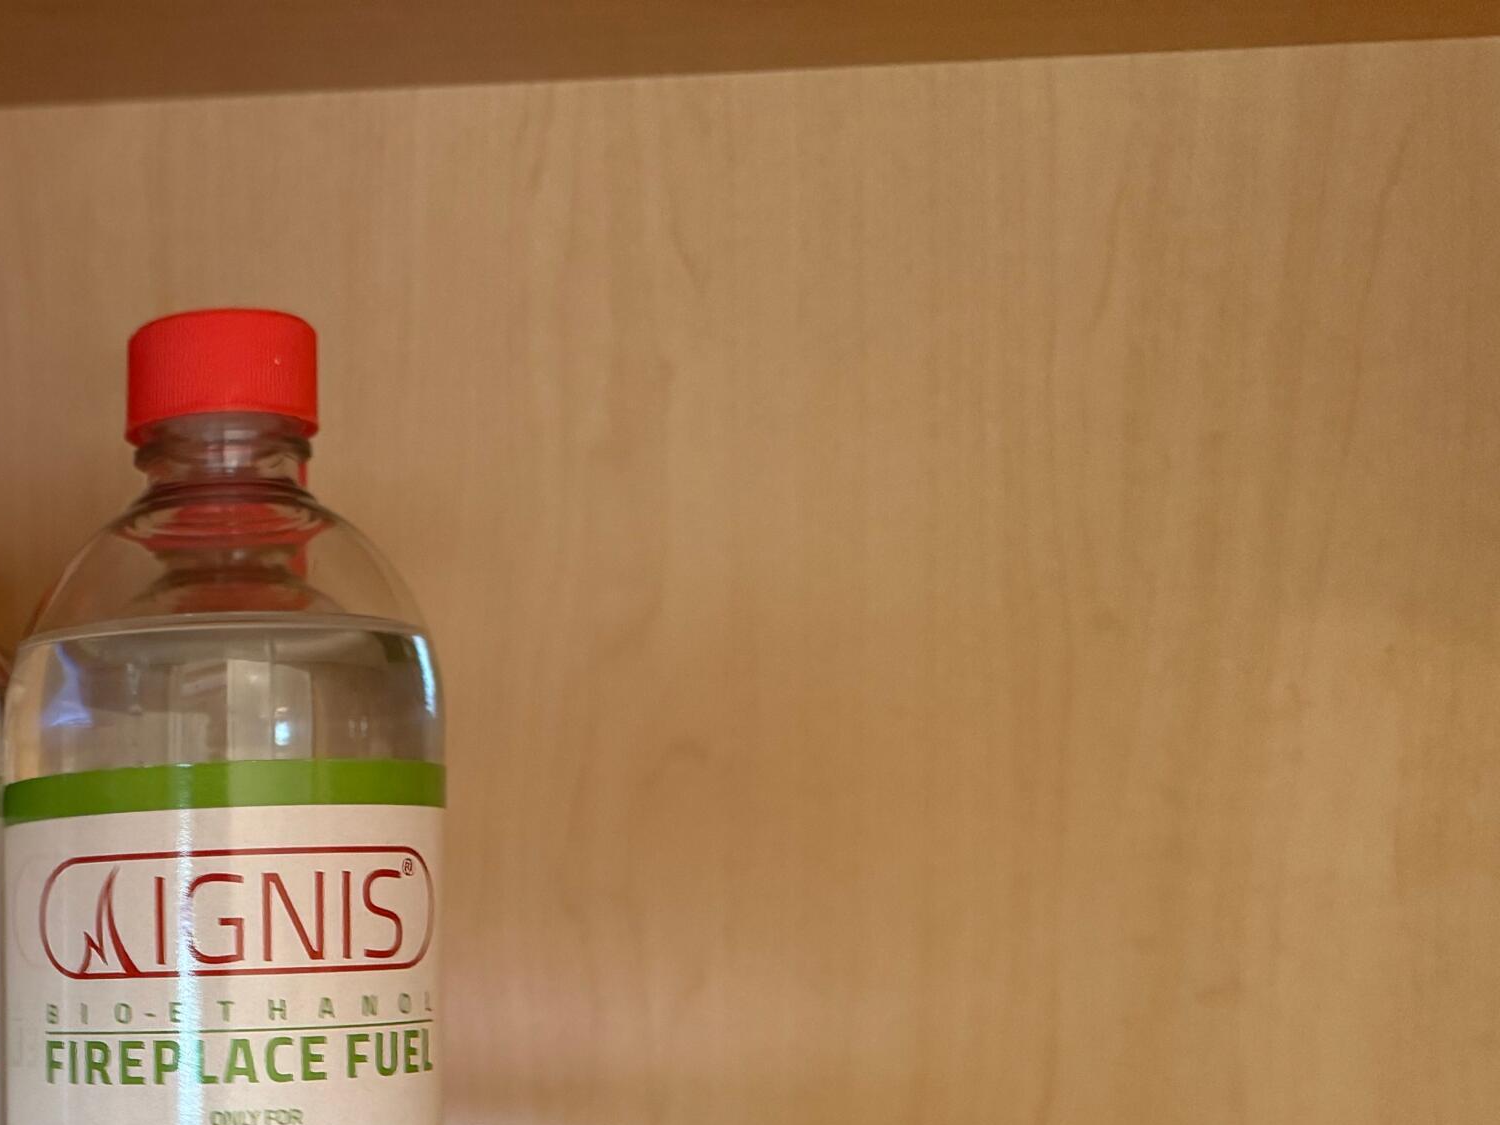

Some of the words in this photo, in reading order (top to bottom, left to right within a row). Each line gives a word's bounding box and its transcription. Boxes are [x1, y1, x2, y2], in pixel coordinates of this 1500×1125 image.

[46, 994, 434, 1025] BIO-ETHANOL
[45, 1034, 328, 1086] FIREPLACE
[347, 1028, 434, 1079] FUEL
[264, 1108, 304, 1125] FOR
